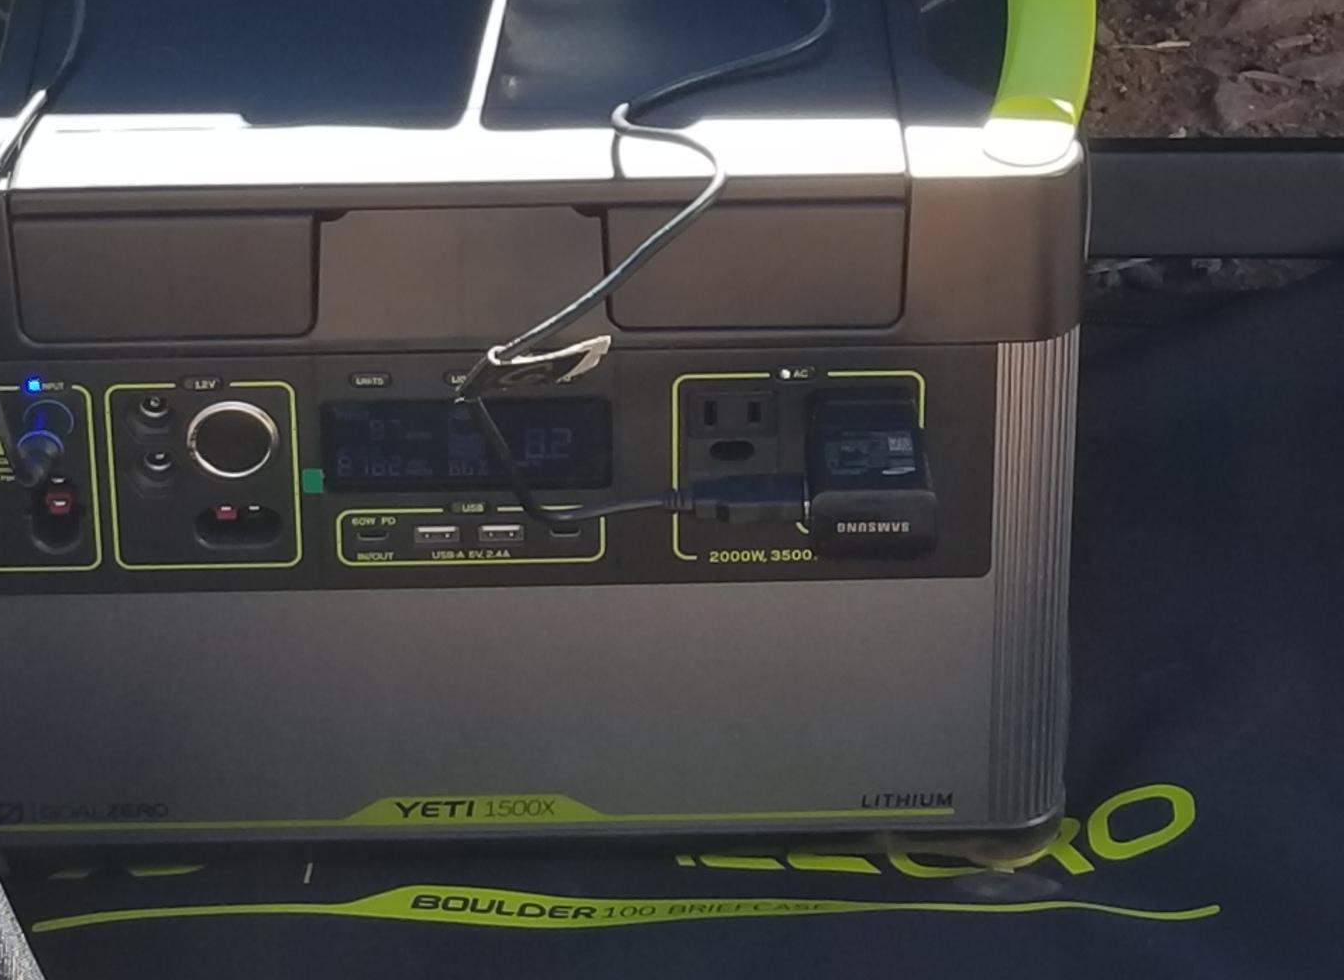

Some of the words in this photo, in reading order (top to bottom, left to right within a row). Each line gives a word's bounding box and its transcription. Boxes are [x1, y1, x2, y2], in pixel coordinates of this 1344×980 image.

[793, 369, 809, 378] AC
[194, 380, 217, 391] 12V
[462, 503, 485, 513] USB
[381, 516, 397, 526] PD
[836, 521, 911, 533] SAMSUNG
[771, 548, 818, 562] 3500
[861, 791, 954, 808] LITHIUM
[395, 800, 475, 819] YETI
[484, 799, 556, 818] 1500X
[410, 894, 598, 920] BOULDER
[602, 905, 657, 918] 100
